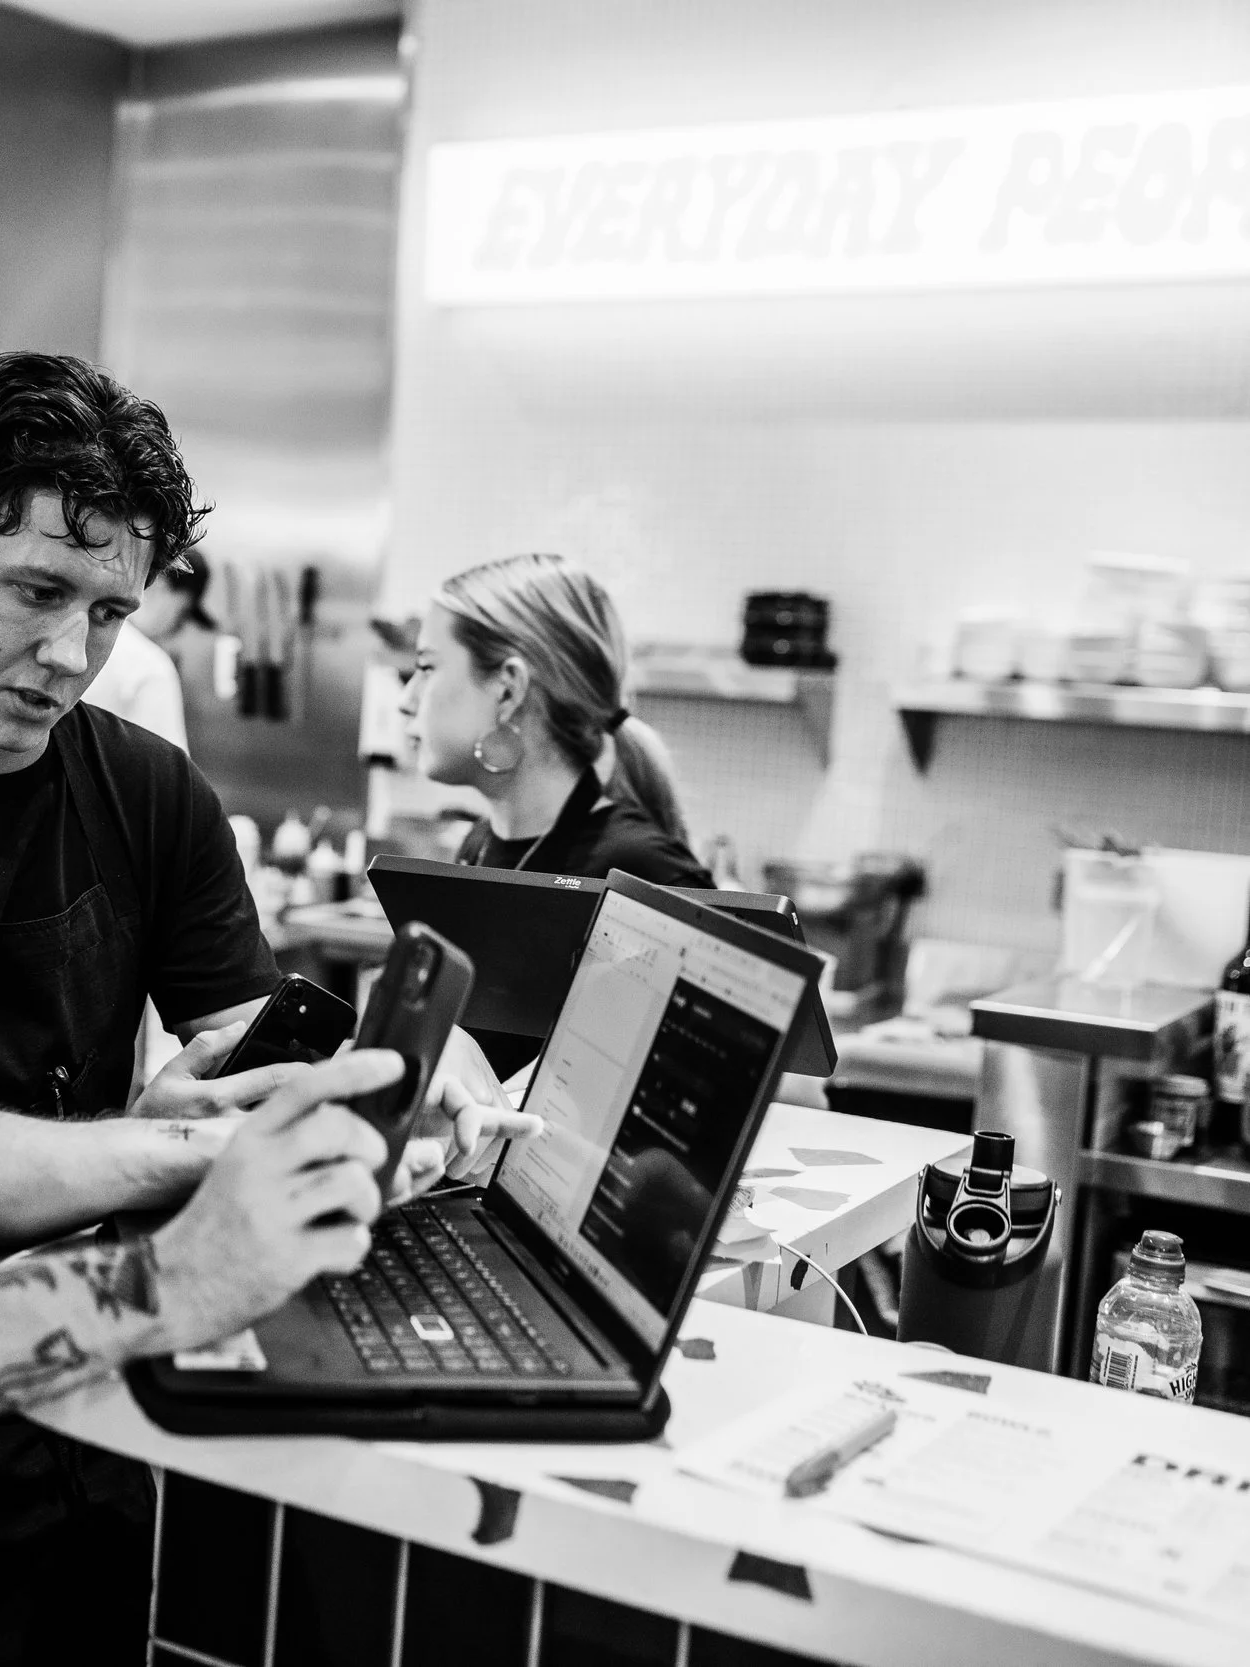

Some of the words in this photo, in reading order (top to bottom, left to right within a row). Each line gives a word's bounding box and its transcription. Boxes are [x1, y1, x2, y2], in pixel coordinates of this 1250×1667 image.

[472, 136, 967, 272] EVERYDAY
[978, 116, 1250, 255] PEOP
[554, 876, 581, 886] Zettle
